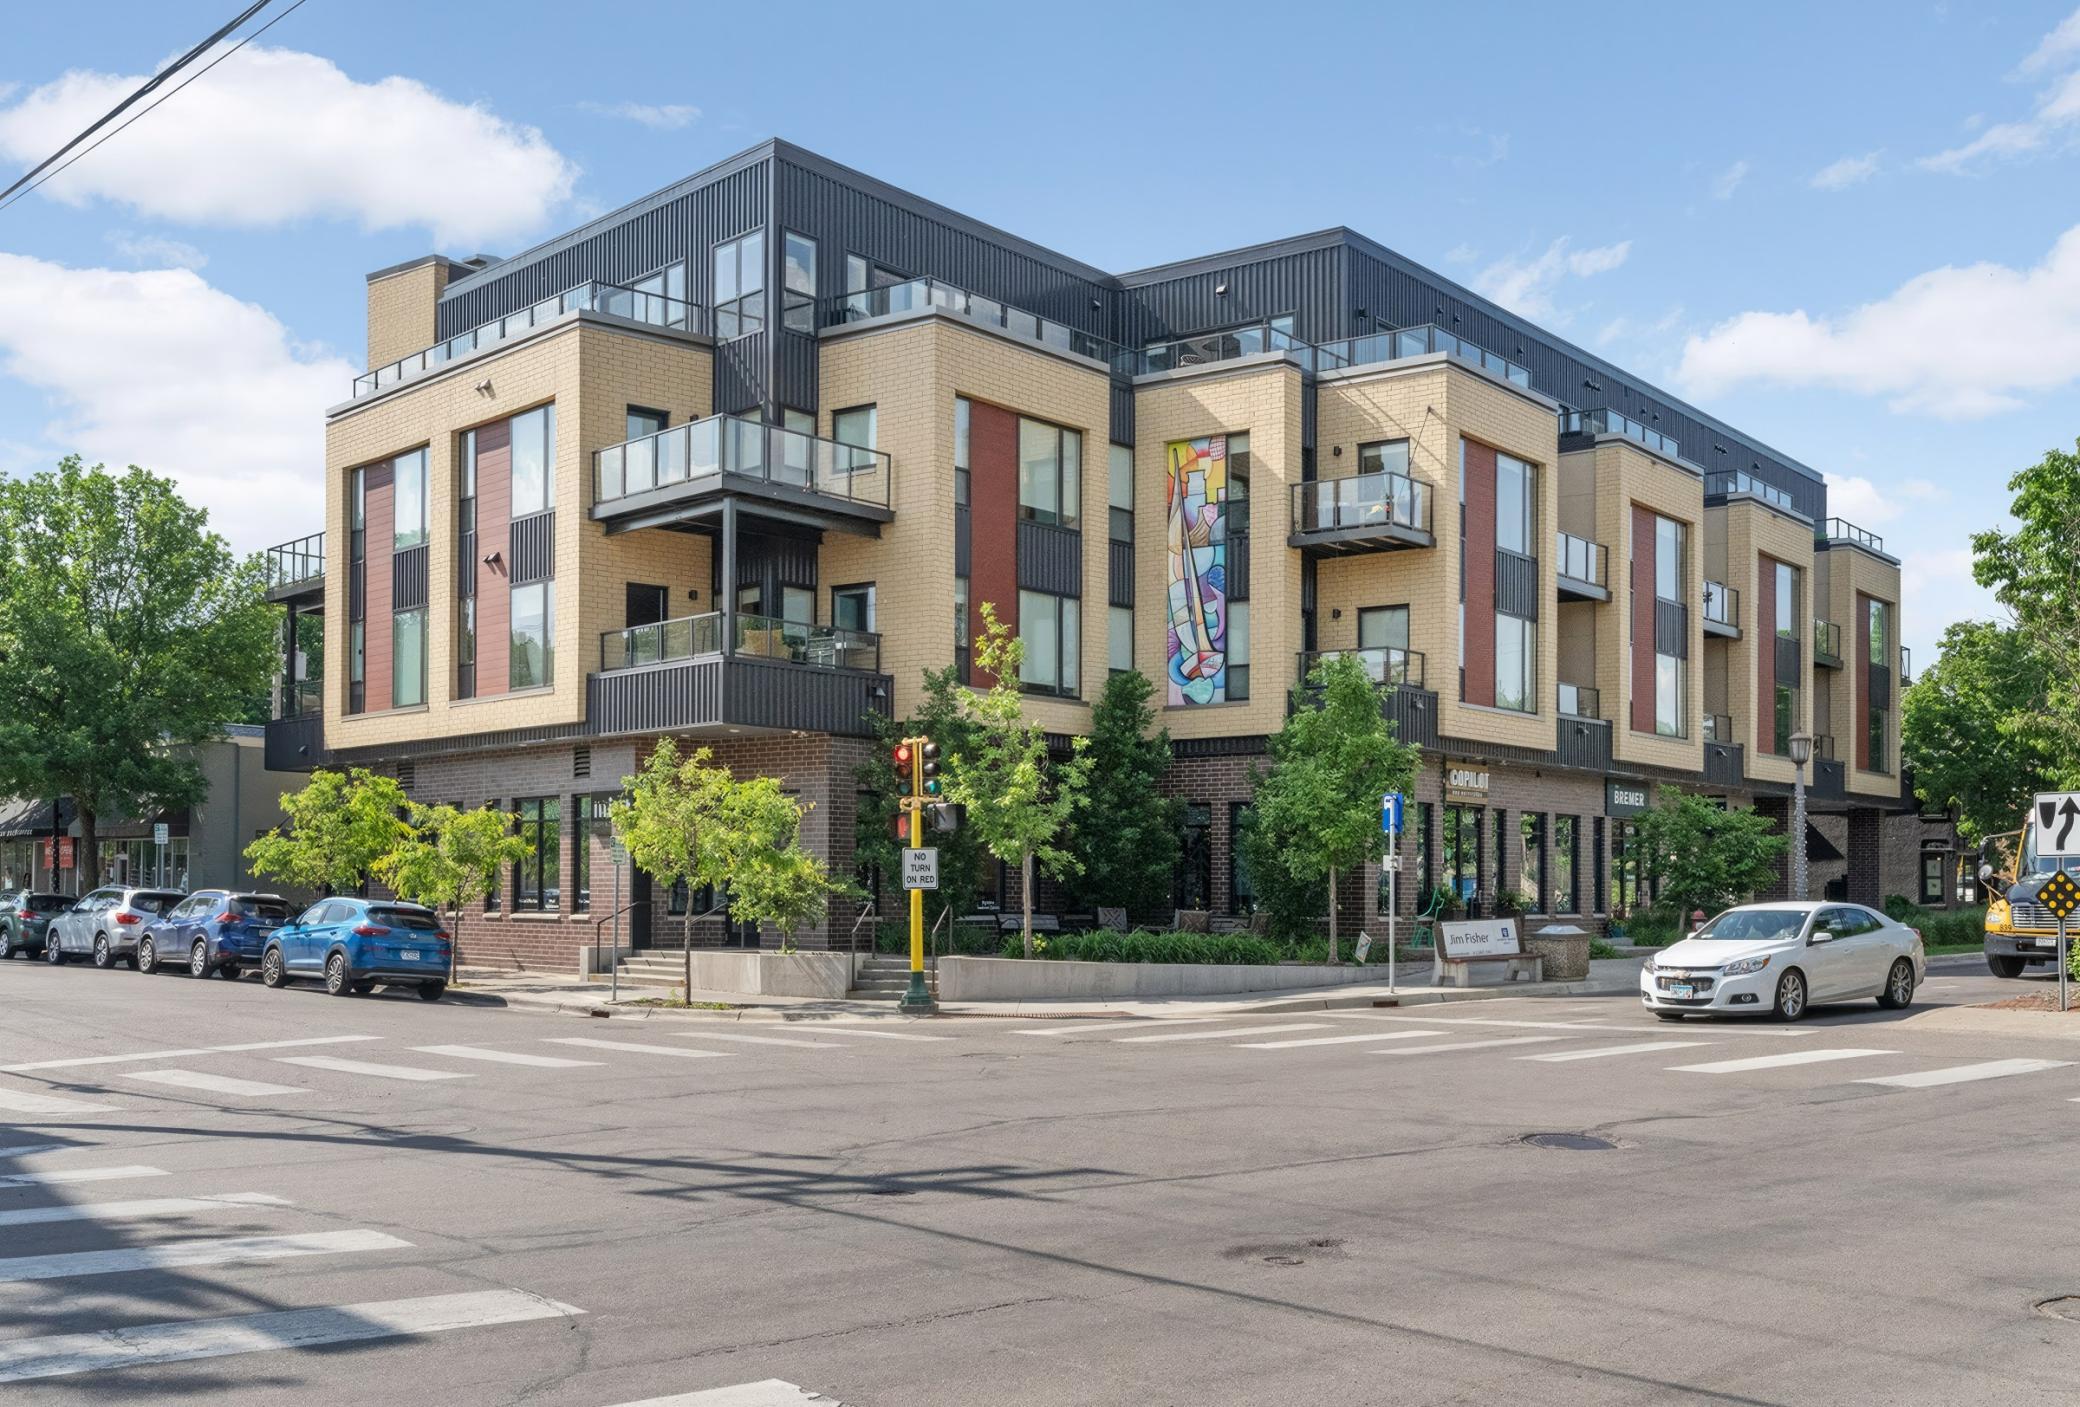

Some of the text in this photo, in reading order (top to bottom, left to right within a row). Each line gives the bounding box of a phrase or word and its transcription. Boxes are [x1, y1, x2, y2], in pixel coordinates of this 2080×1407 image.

[1450, 769, 1489, 788] COPILOT
[1614, 790, 1645, 806] BREMER
[914, 852, 927, 861] NO
[911, 864, 931, 872] TURN
[906, 875, 935, 883] ON RED
[1450, 934, 1464, 945] Jim
[1464, 932, 1489, 944] Fisher
